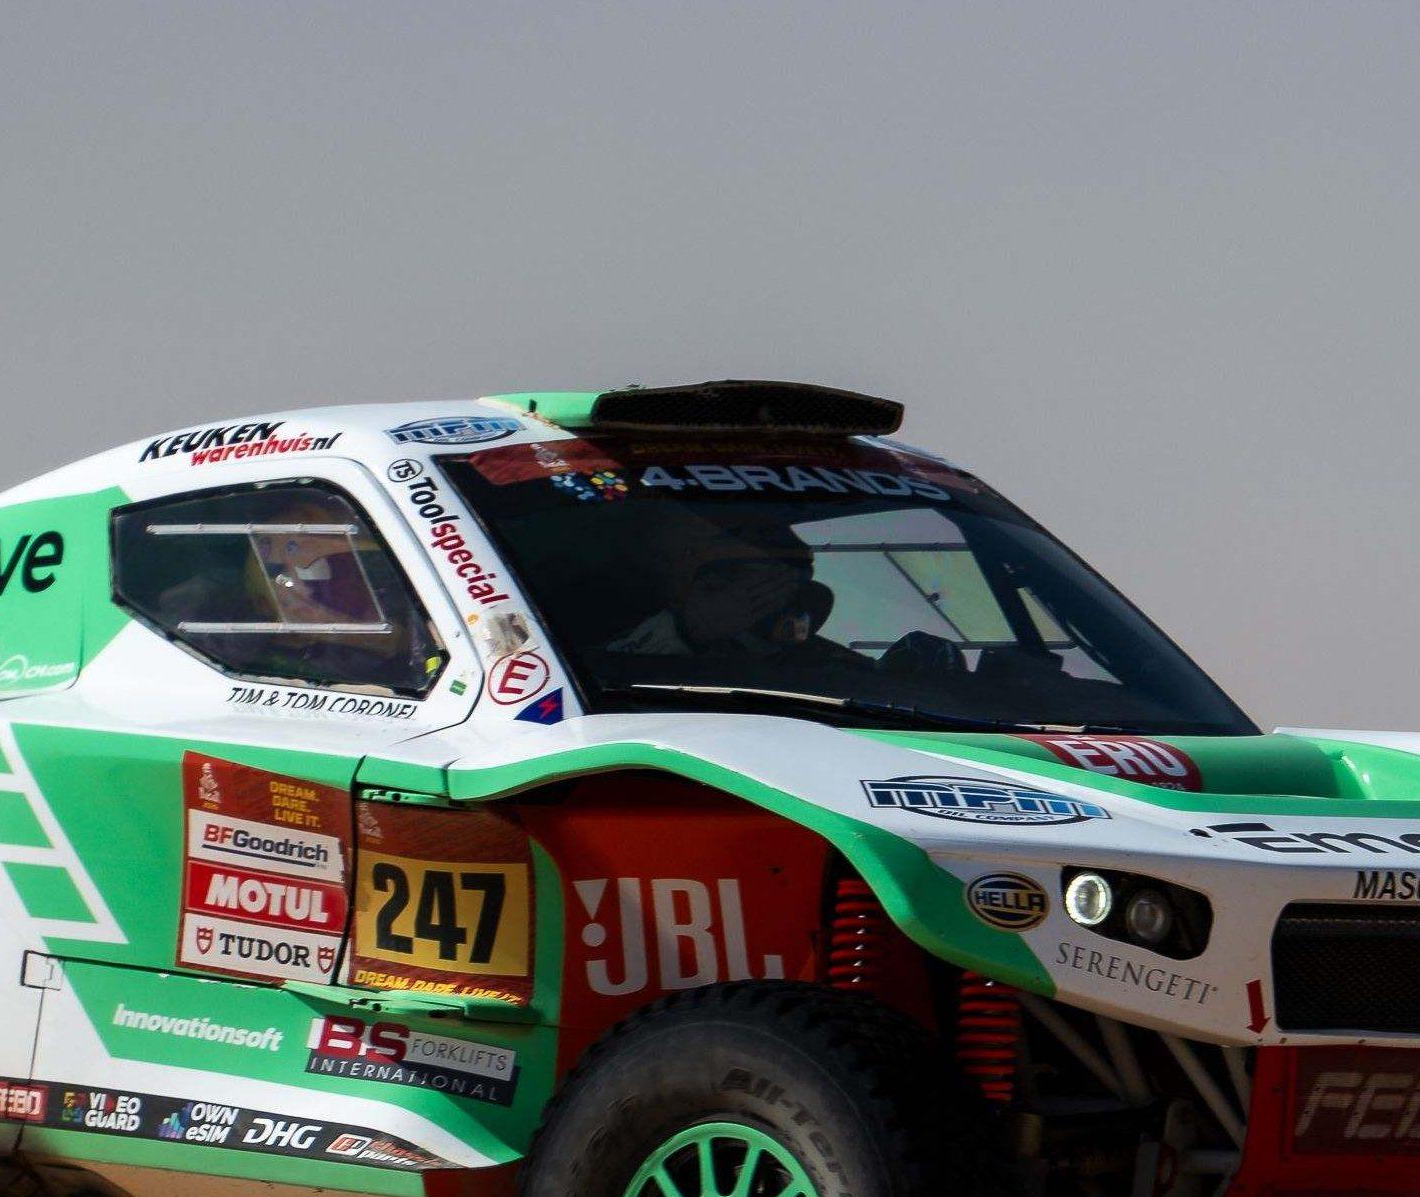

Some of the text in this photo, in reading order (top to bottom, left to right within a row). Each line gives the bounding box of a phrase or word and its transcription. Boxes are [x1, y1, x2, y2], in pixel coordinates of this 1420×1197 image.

[138, 422, 286, 463] KEUKEN
[407, 475, 510, 605] Toolspecial
[497, 659, 538, 695] E
[227, 687, 264, 704] TIM
[262, 691, 280, 706] &
[282, 692, 328, 711] TOM
[1046, 740, 1189, 777] ERU
[275, 808, 304, 826] LIVE
[204, 824, 328, 862] BFGoodrich
[204, 874, 329, 924] MOTUL
[372, 862, 507, 964] 247
[974, 887, 1047, 912] HELLA
[219, 933, 311, 968] TUDOR
[113, 1003, 284, 1052] Innovationsoft
[317, 1014, 509, 1072] BS FORKLIFTS
[310, 1056, 499, 1102] INTERNATIONAL
[84, 1109, 141, 1132] GUARD
[191, 1102, 240, 1125] OWN
[185, 1125, 232, 1145] eSIM
[242, 1117, 323, 1150] DHG
